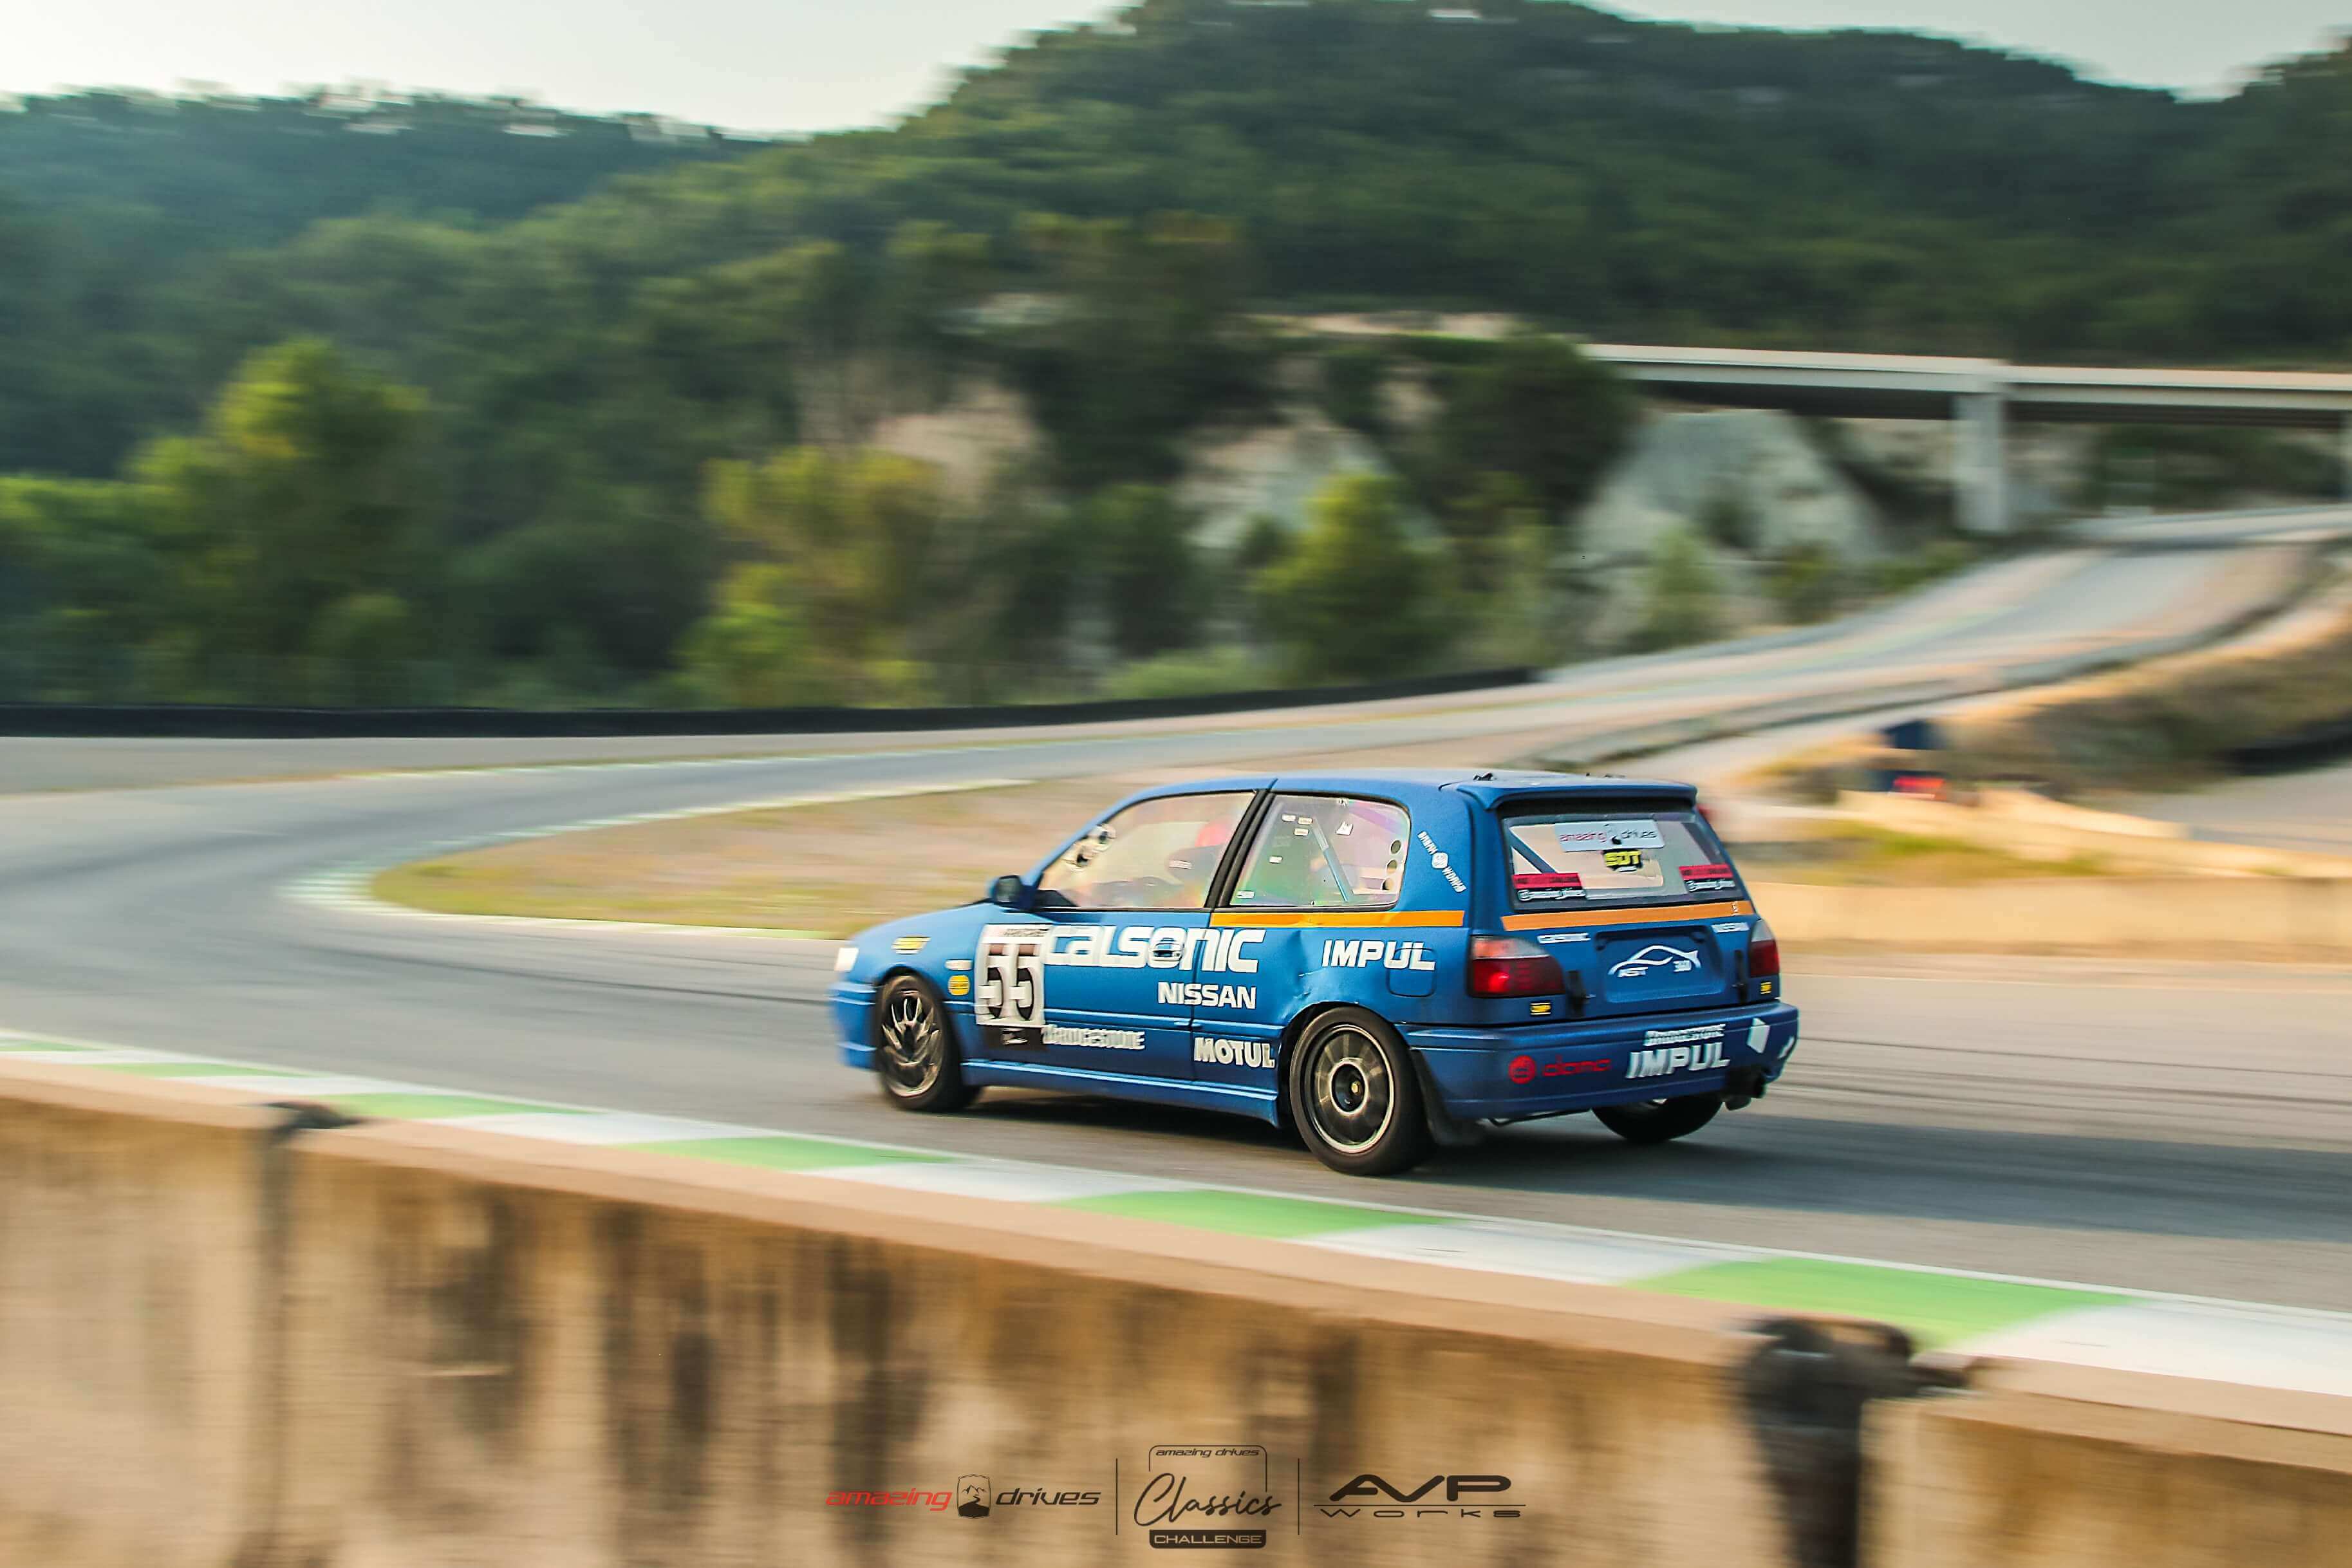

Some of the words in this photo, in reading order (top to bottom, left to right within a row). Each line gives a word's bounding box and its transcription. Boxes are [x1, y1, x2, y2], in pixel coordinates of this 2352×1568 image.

[1321, 939, 1436, 971] IMPUL
[981, 942, 1036, 1022] 55
[1157, 982, 1256, 1009] NISSAN
[1193, 1036, 1275, 1069] MOTUL
[1625, 1041, 1730, 1079] IMPUL
